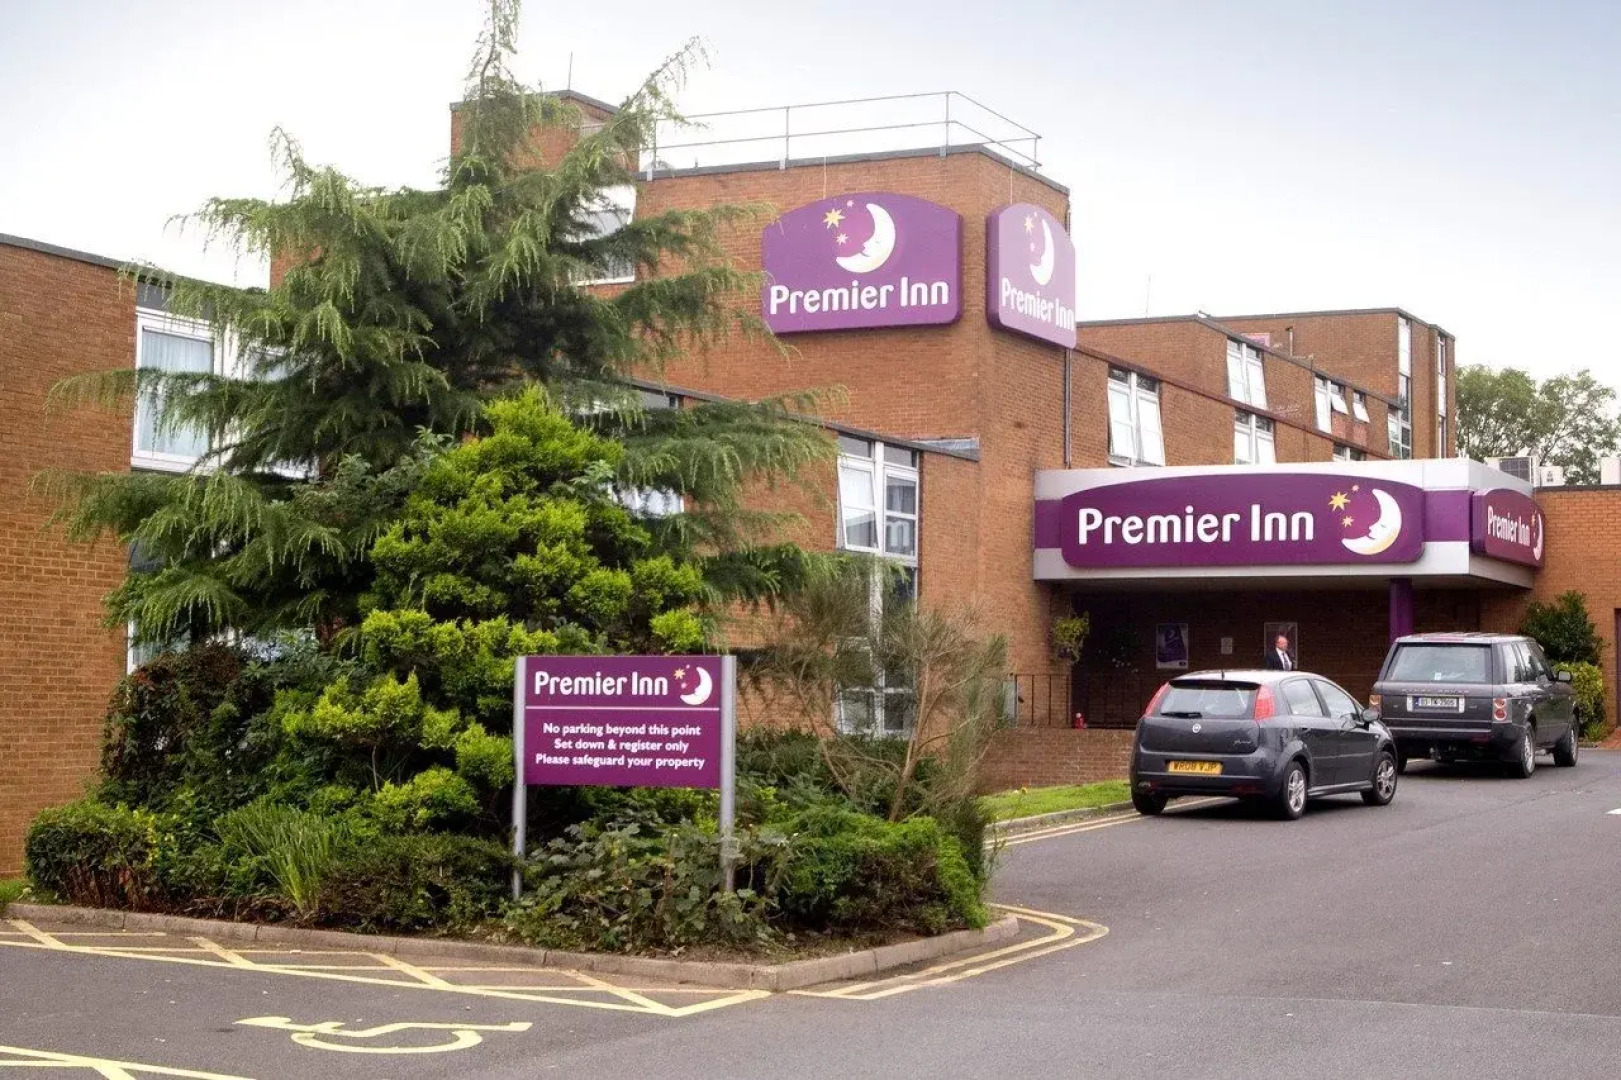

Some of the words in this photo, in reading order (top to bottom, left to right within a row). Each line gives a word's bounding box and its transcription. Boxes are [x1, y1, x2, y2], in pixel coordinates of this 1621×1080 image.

[770, 280, 894, 314] Premier
[901, 277, 949, 306] Inn
[1001, 277, 1055, 322] Premier
[1055, 298, 1075, 331] Inn
[1078, 506, 1240, 544] Premier
[1251, 504, 1314, 542] Inn
[1488, 505, 1517, 542] Premier
[1518, 516, 1530, 546] Inn
[534, 671, 627, 695] Premier
[632, 671, 668, 696] Inn
[543, 723, 560, 734] No
[562, 723, 603, 737] parking
[606, 723, 646, 737] beyond
[648, 725, 669, 735] this
[671, 725, 701, 737] point
[554, 739, 573, 749] Set
[575, 739, 604, 750] down
[608, 740, 616, 750] &
[619, 741, 663, 752] register
[665, 741, 689, 753] only
[536, 754, 569, 764] Please
[572, 754, 625, 767] safeguard
[627, 758, 653, 768] your
[655, 758, 705, 770] property
